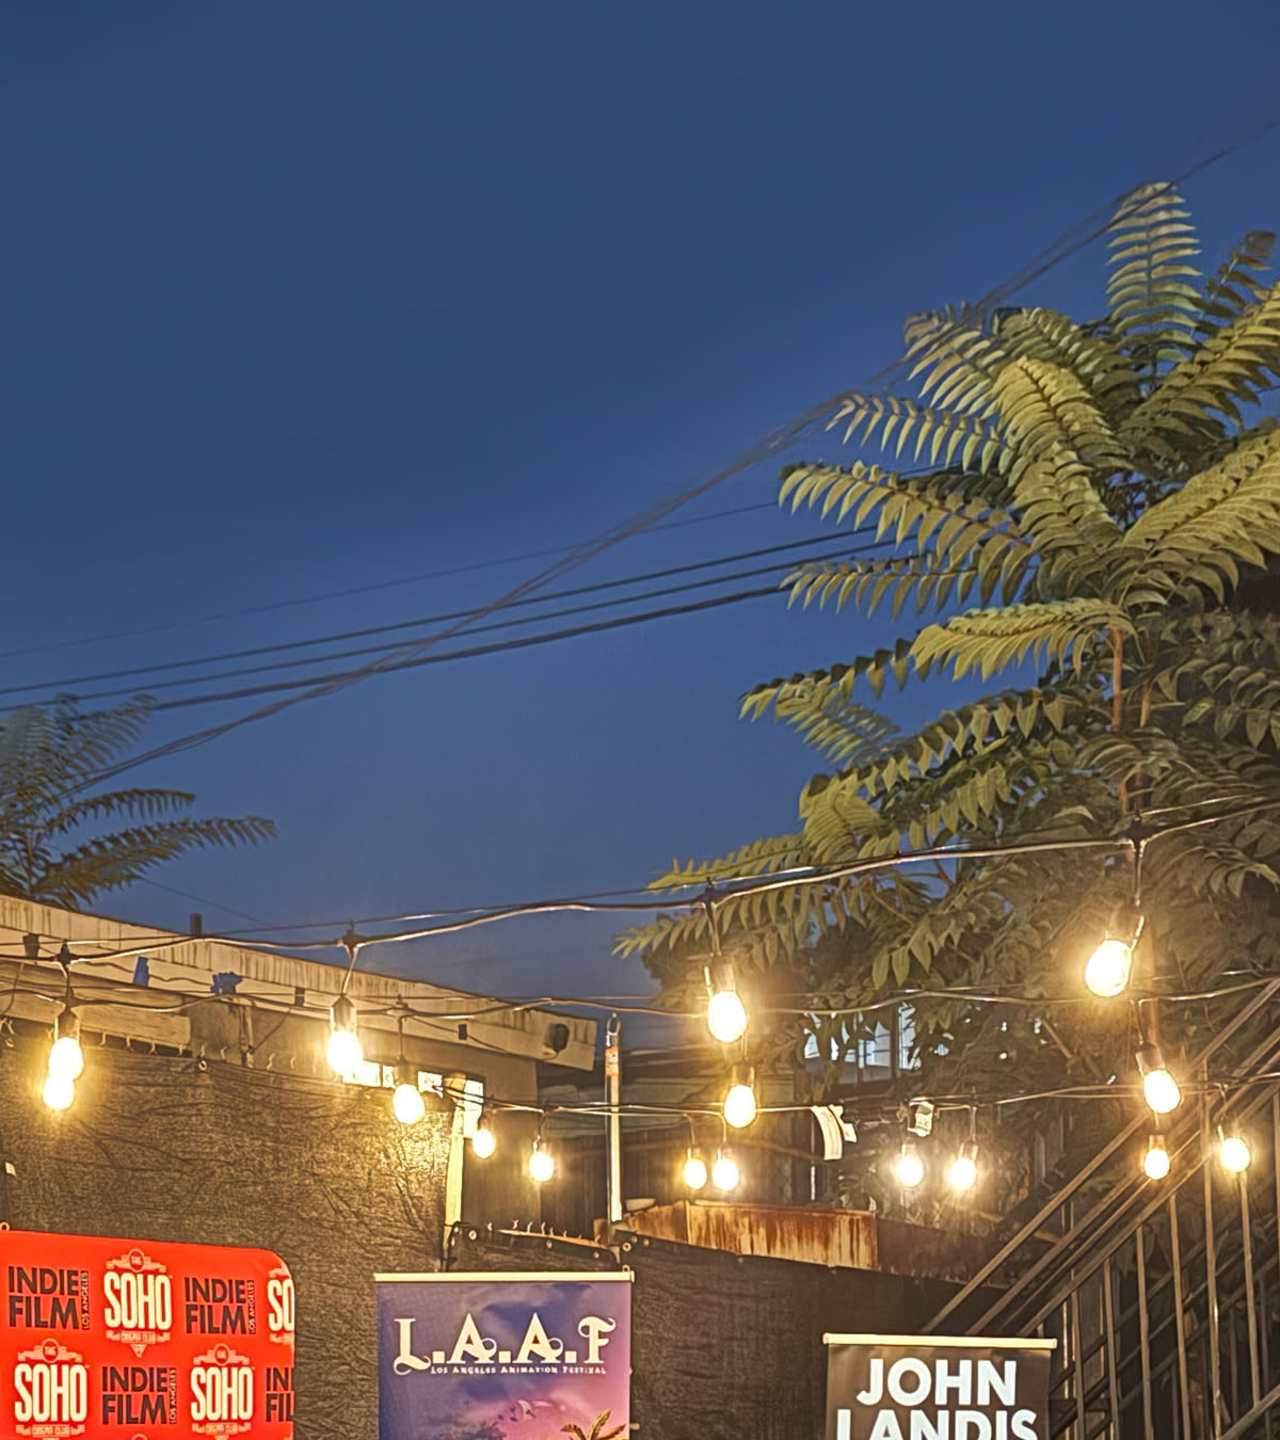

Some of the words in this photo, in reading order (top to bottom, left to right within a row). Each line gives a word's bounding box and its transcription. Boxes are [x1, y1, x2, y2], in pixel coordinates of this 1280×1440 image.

[8, 1266, 79, 1296] INDIE
[184, 1277, 246, 1304] INDIE
[8, 1295, 79, 1330] FILM
[104, 1271, 172, 1331] SOHO
[268, 1279, 295, 1331] SO
[185, 1304, 247, 1335] FILM
[15, 1363, 88, 1422] SOHO
[102, 1366, 168, 1392] INDIE
[190, 1366, 254, 1421] SOHO
[856, 1357, 1017, 1406] JOHN
[102, 1394, 167, 1425] FILM
[266, 1393, 294, 1422] FIL
